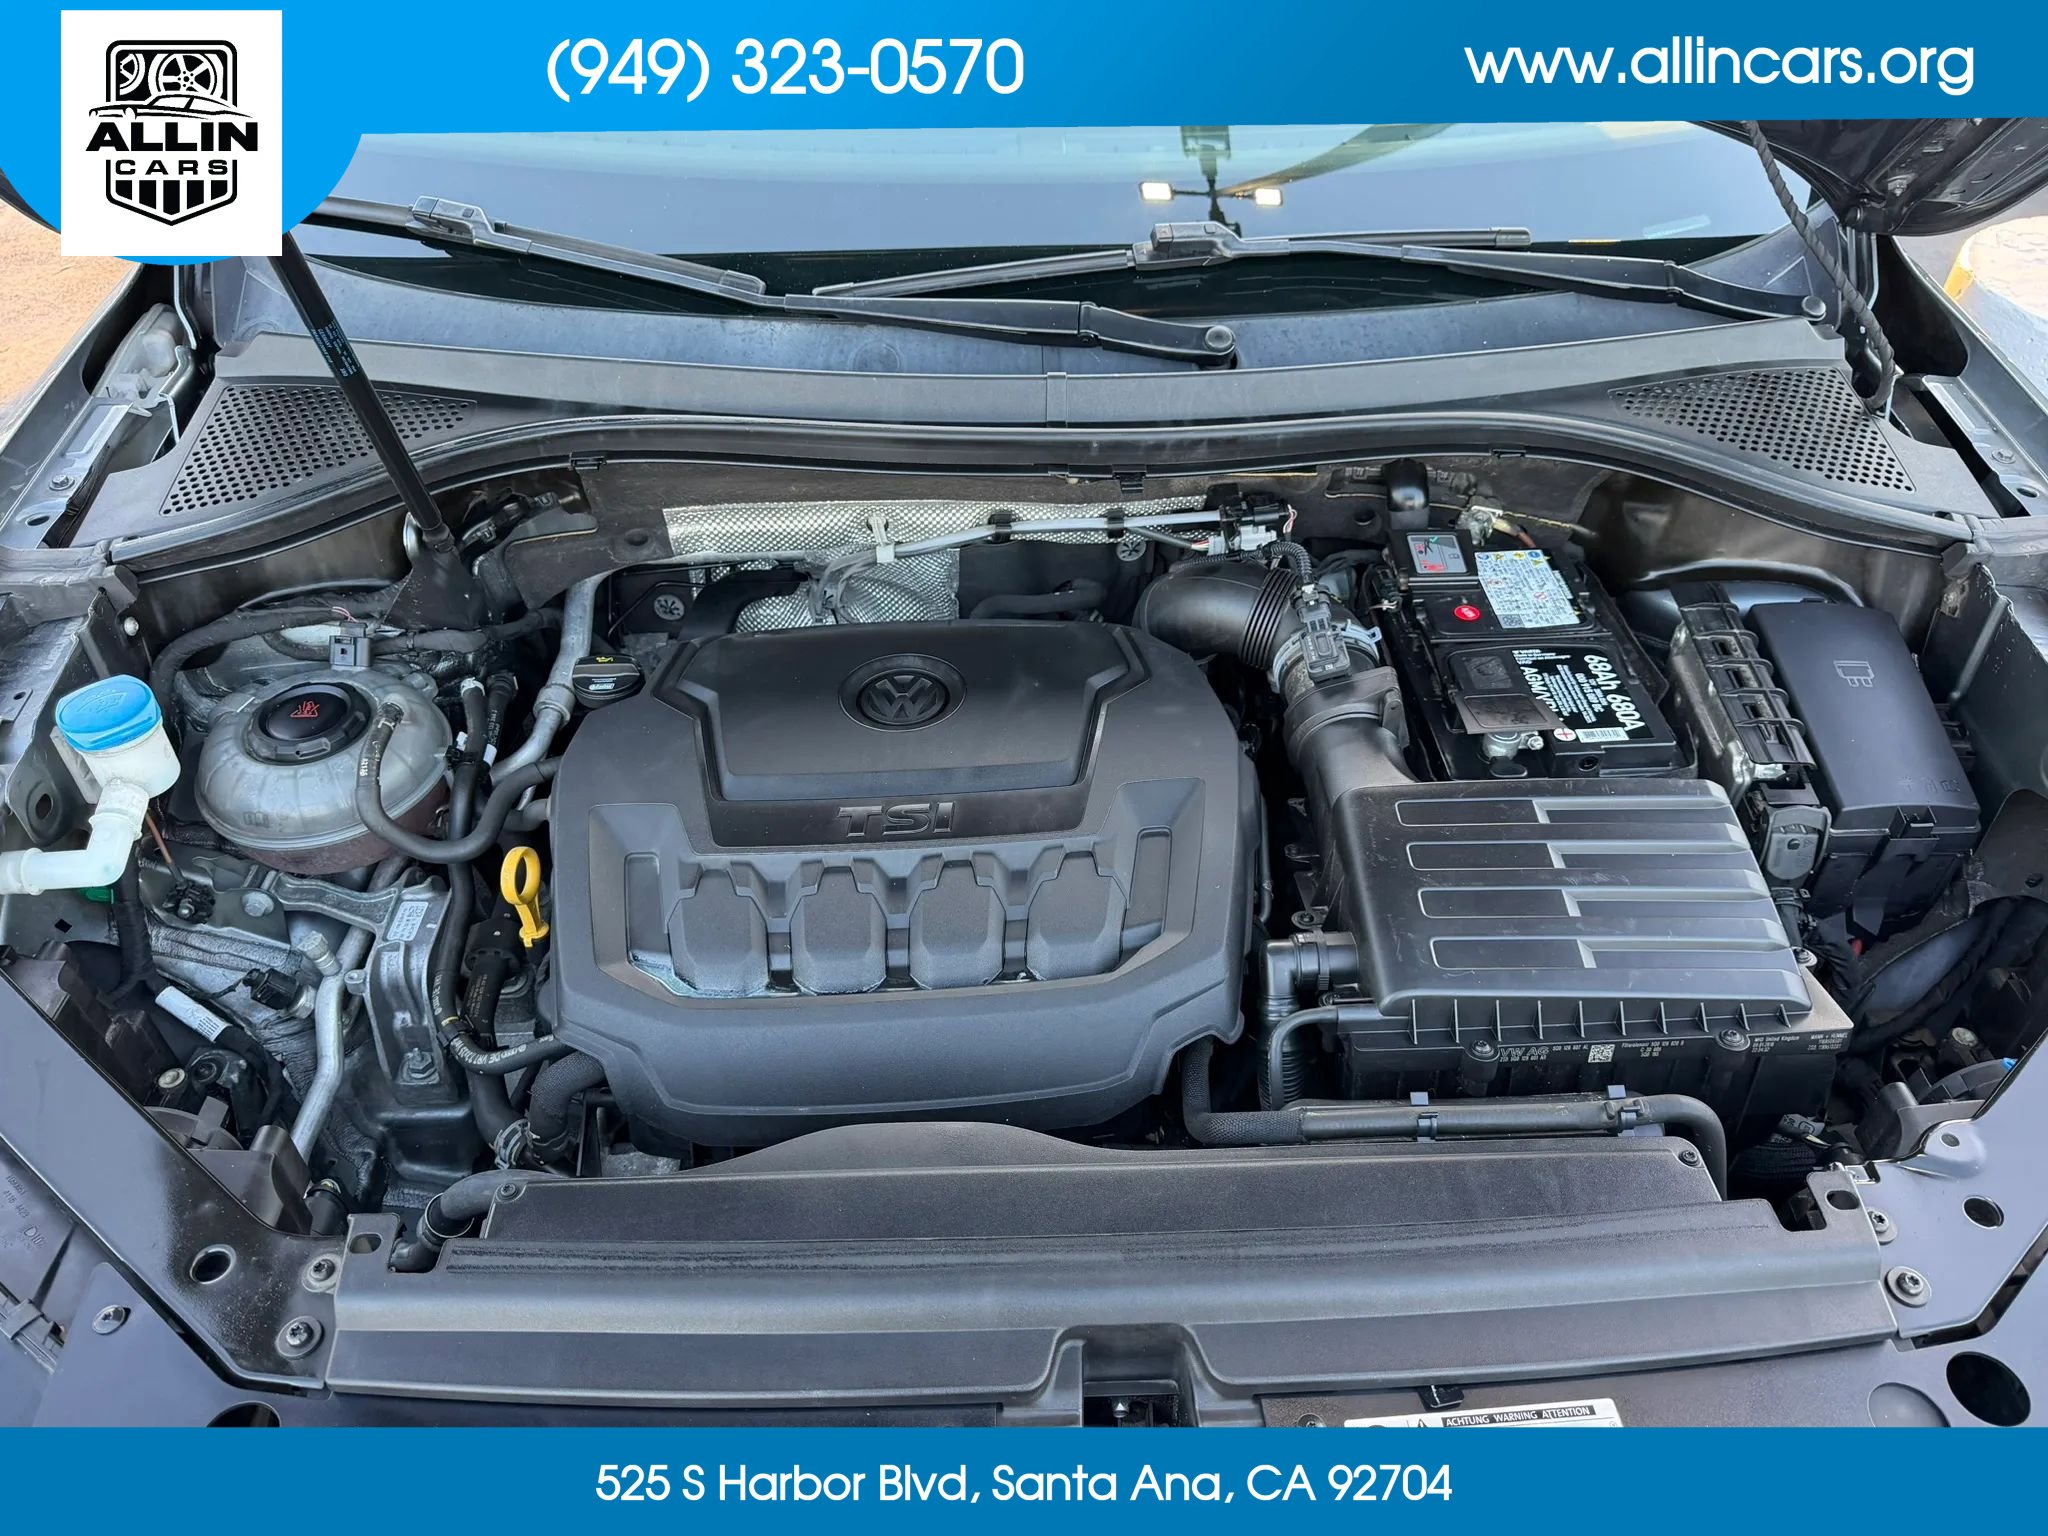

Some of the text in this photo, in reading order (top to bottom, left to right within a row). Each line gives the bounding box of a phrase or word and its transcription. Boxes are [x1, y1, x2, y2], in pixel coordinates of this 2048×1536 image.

[1584, 655, 1621, 690] 68Ah
[1606, 694, 1645, 731] 680A
[837, 802, 956, 838] TSI
[1445, 1406, 1591, 1427] ACHTUNG WARNING ATTENTION
